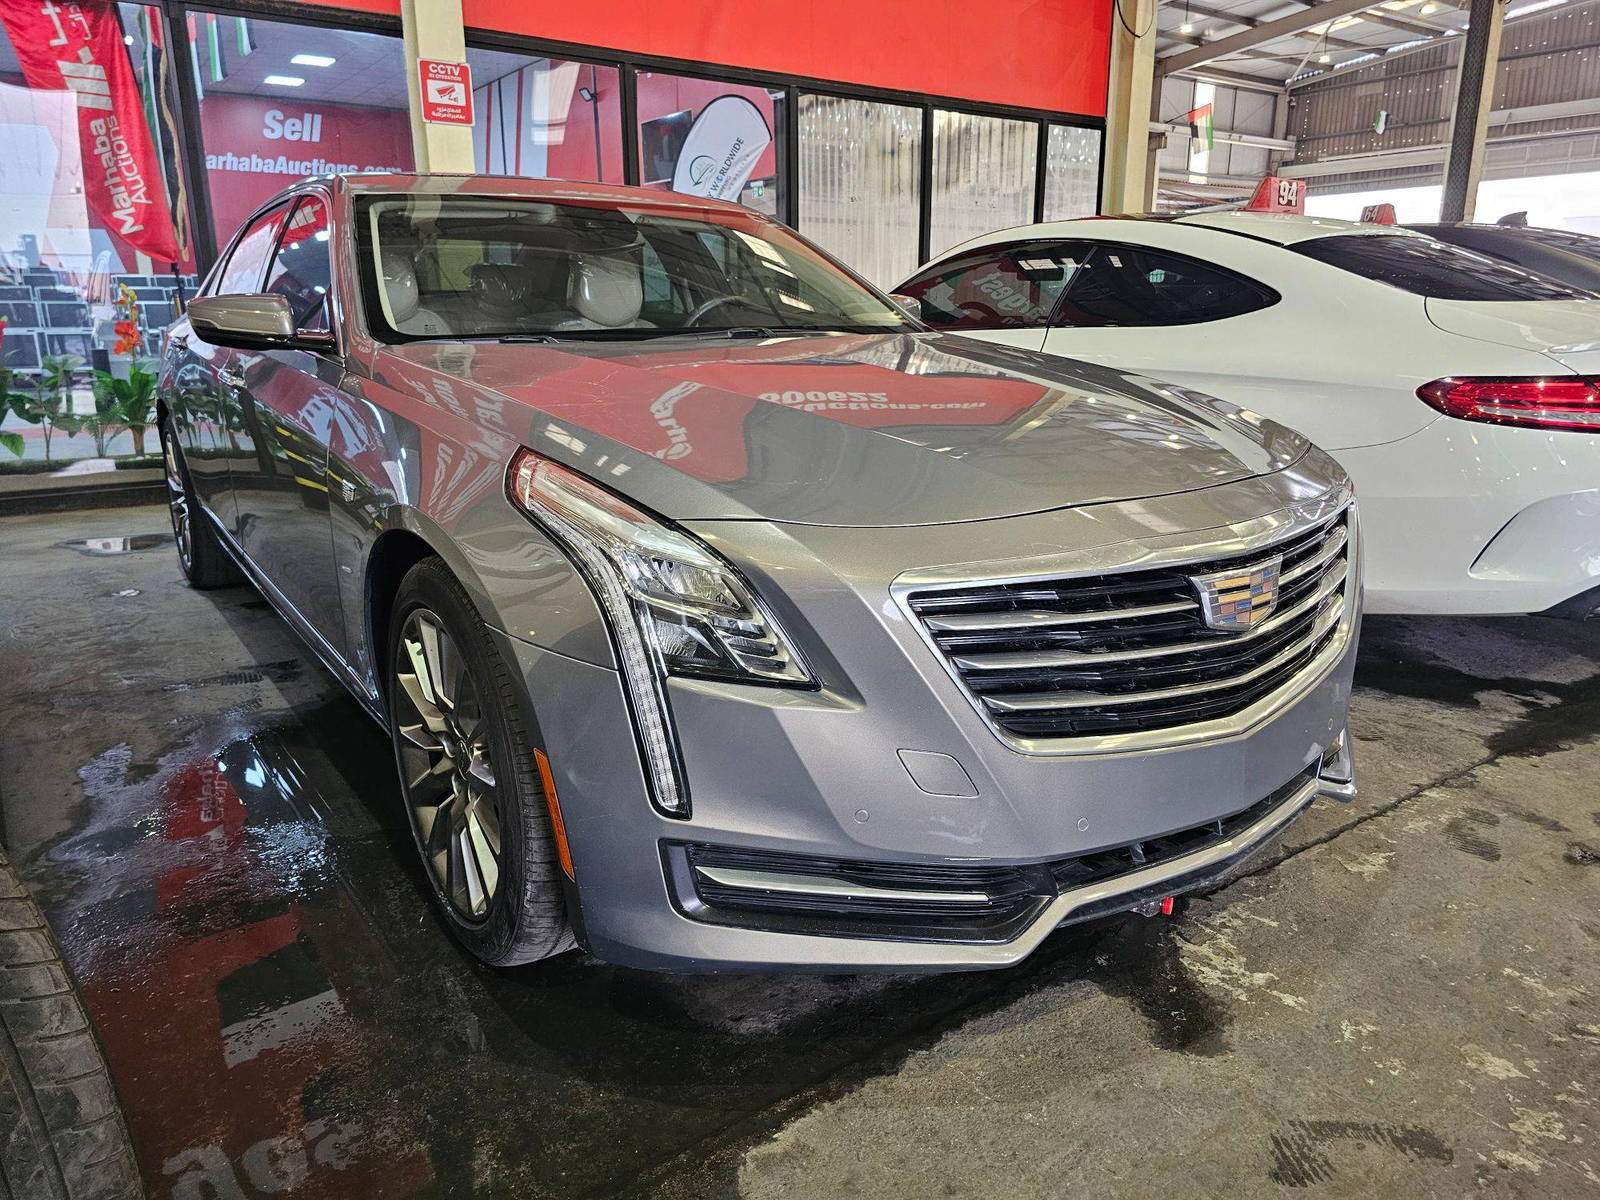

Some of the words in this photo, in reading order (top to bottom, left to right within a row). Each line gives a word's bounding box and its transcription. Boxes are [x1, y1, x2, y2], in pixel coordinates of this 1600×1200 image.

[428, 64, 460, 76] CCTV
[262, 109, 322, 142] Sell
[107, 115, 152, 204] Auctions
[90, 118, 144, 235] Marhaba
[1279, 181, 1297, 207] 94
[1364, 205, 1378, 222] 64
